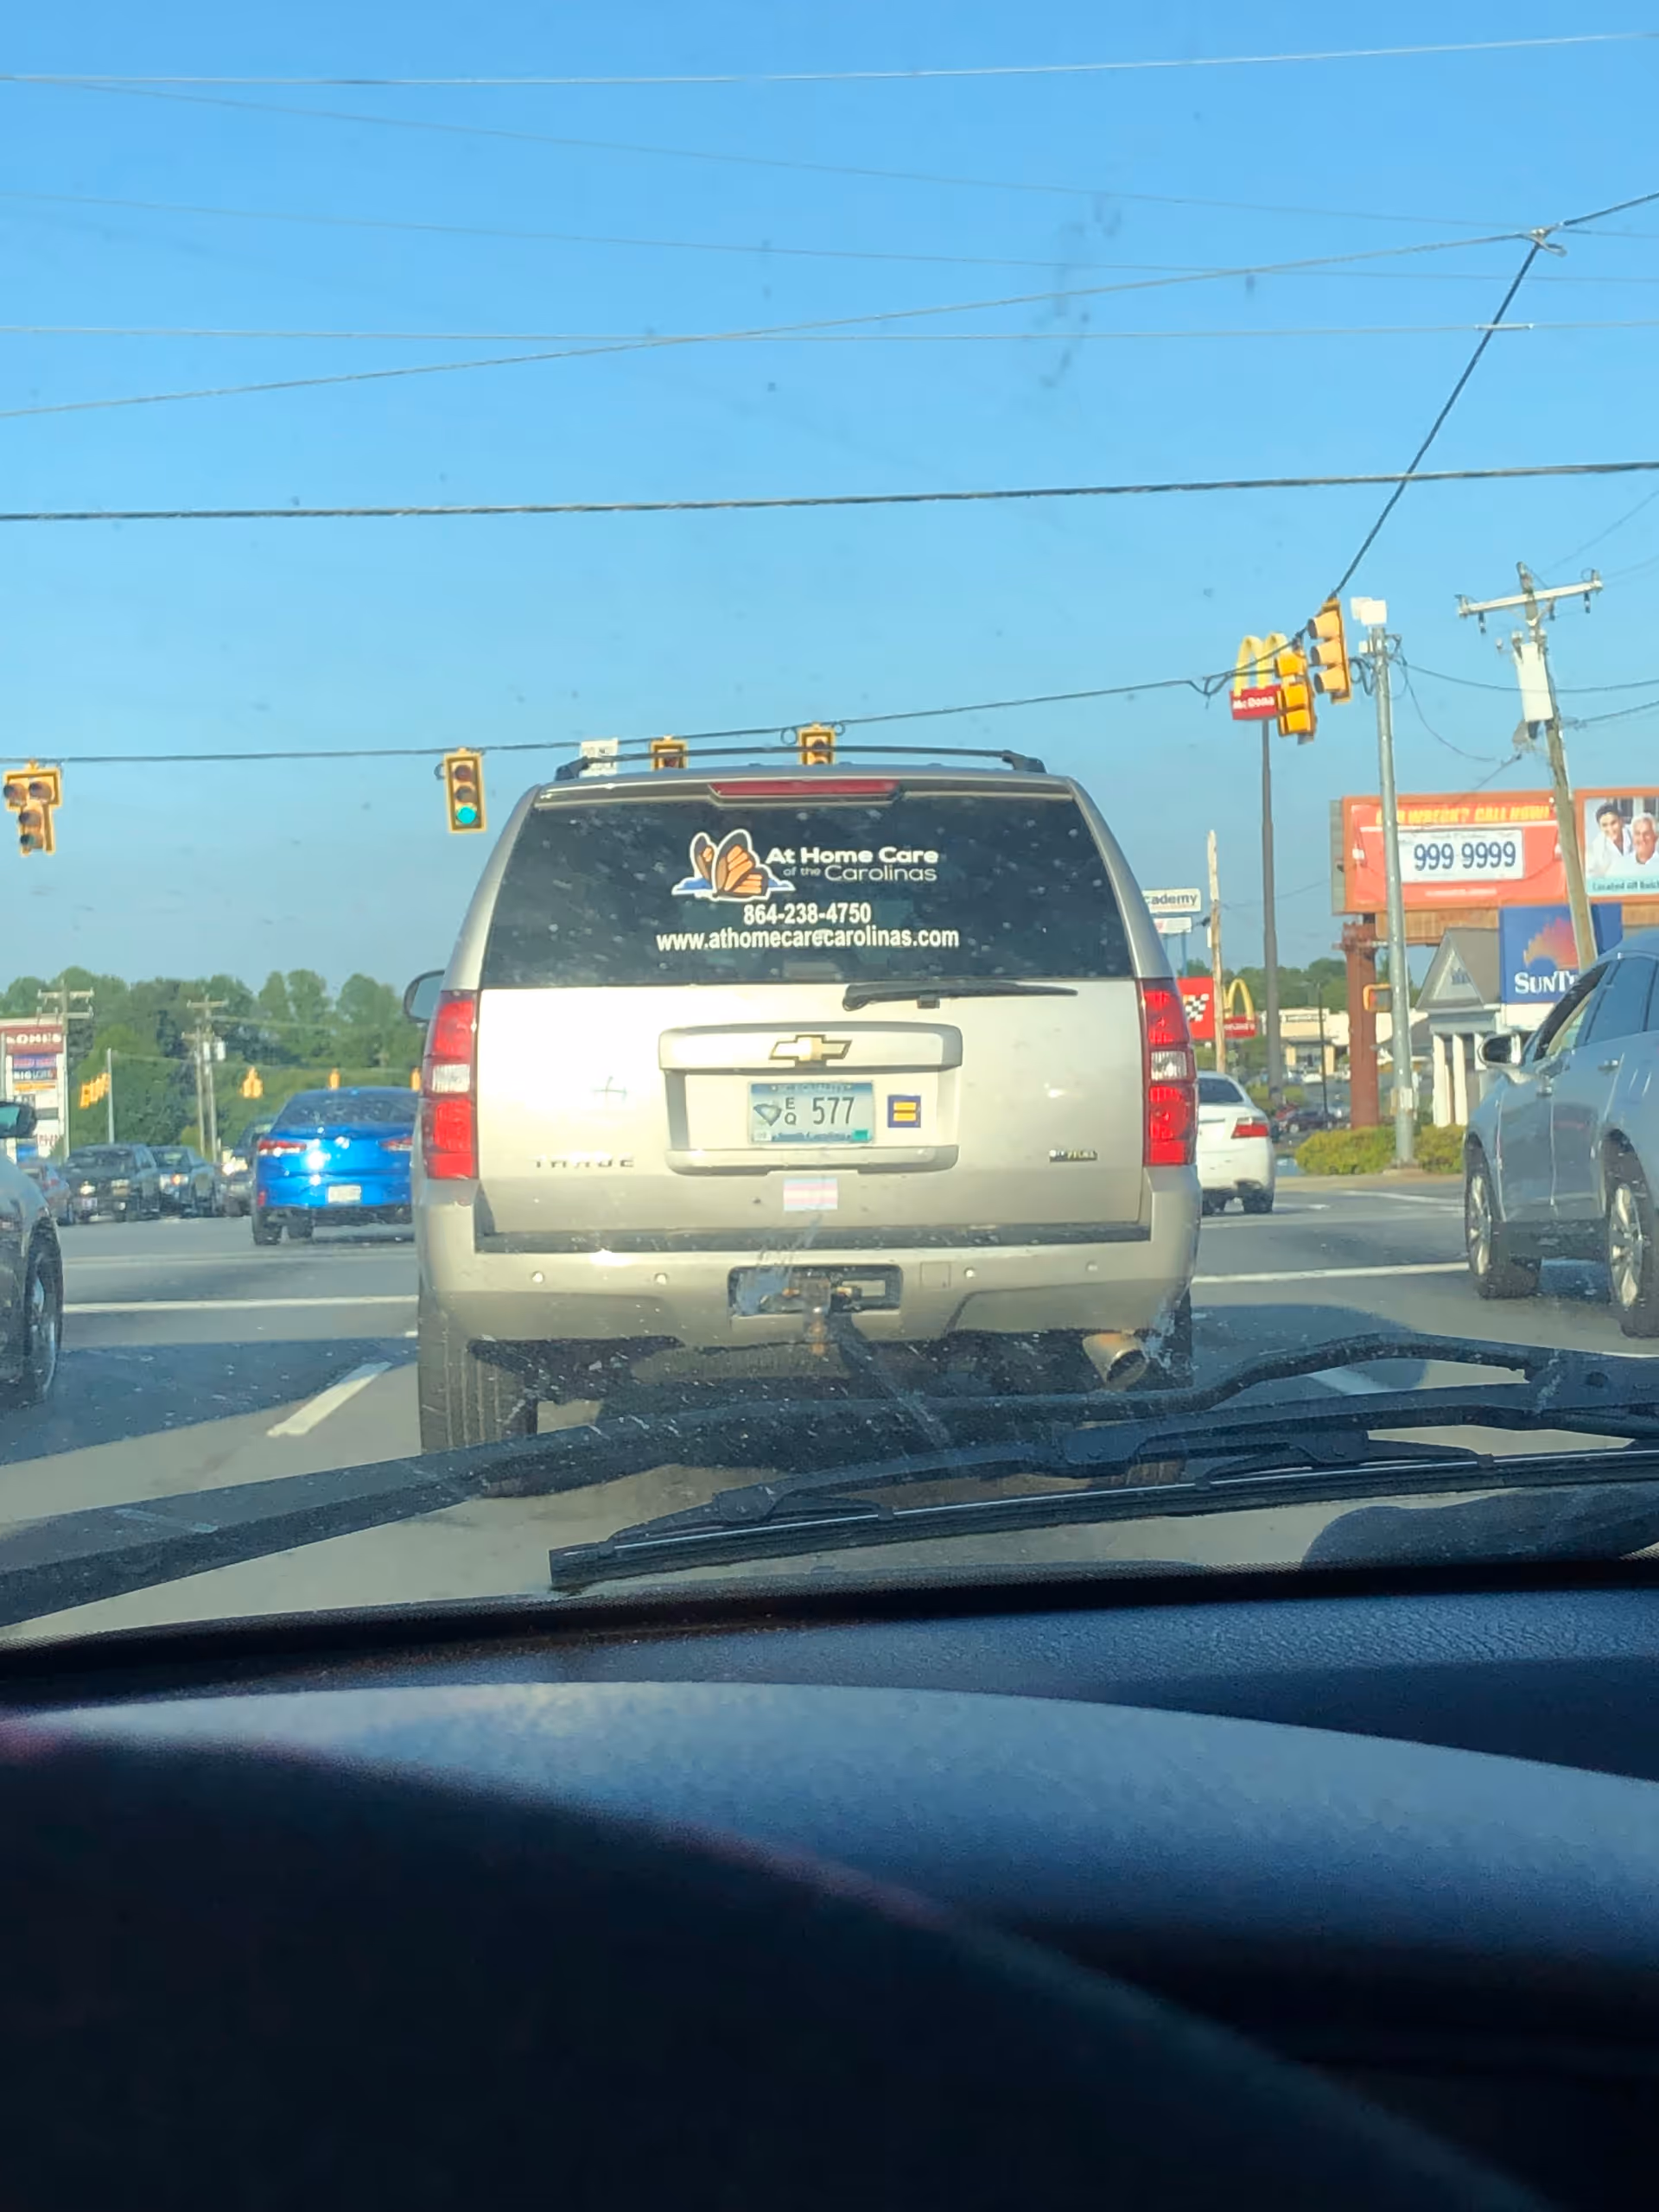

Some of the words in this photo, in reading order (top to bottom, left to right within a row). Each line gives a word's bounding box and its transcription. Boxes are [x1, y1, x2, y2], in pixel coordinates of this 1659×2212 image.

[766, 847, 795, 864] At
[800, 847, 874, 864] Home
[879, 846, 939, 864] Care
[1414, 842, 1454, 871] 999
[1461, 841, 1516, 868] 9999
[783, 867, 797, 876] of
[800, 867, 821, 876] the
[824, 865, 938, 881] Carolinas
[743, 902, 872, 925] 864-238-4750
[656, 925, 960, 951] www.athomecarecarolinas.com
[811, 1096, 855, 1125] 577
